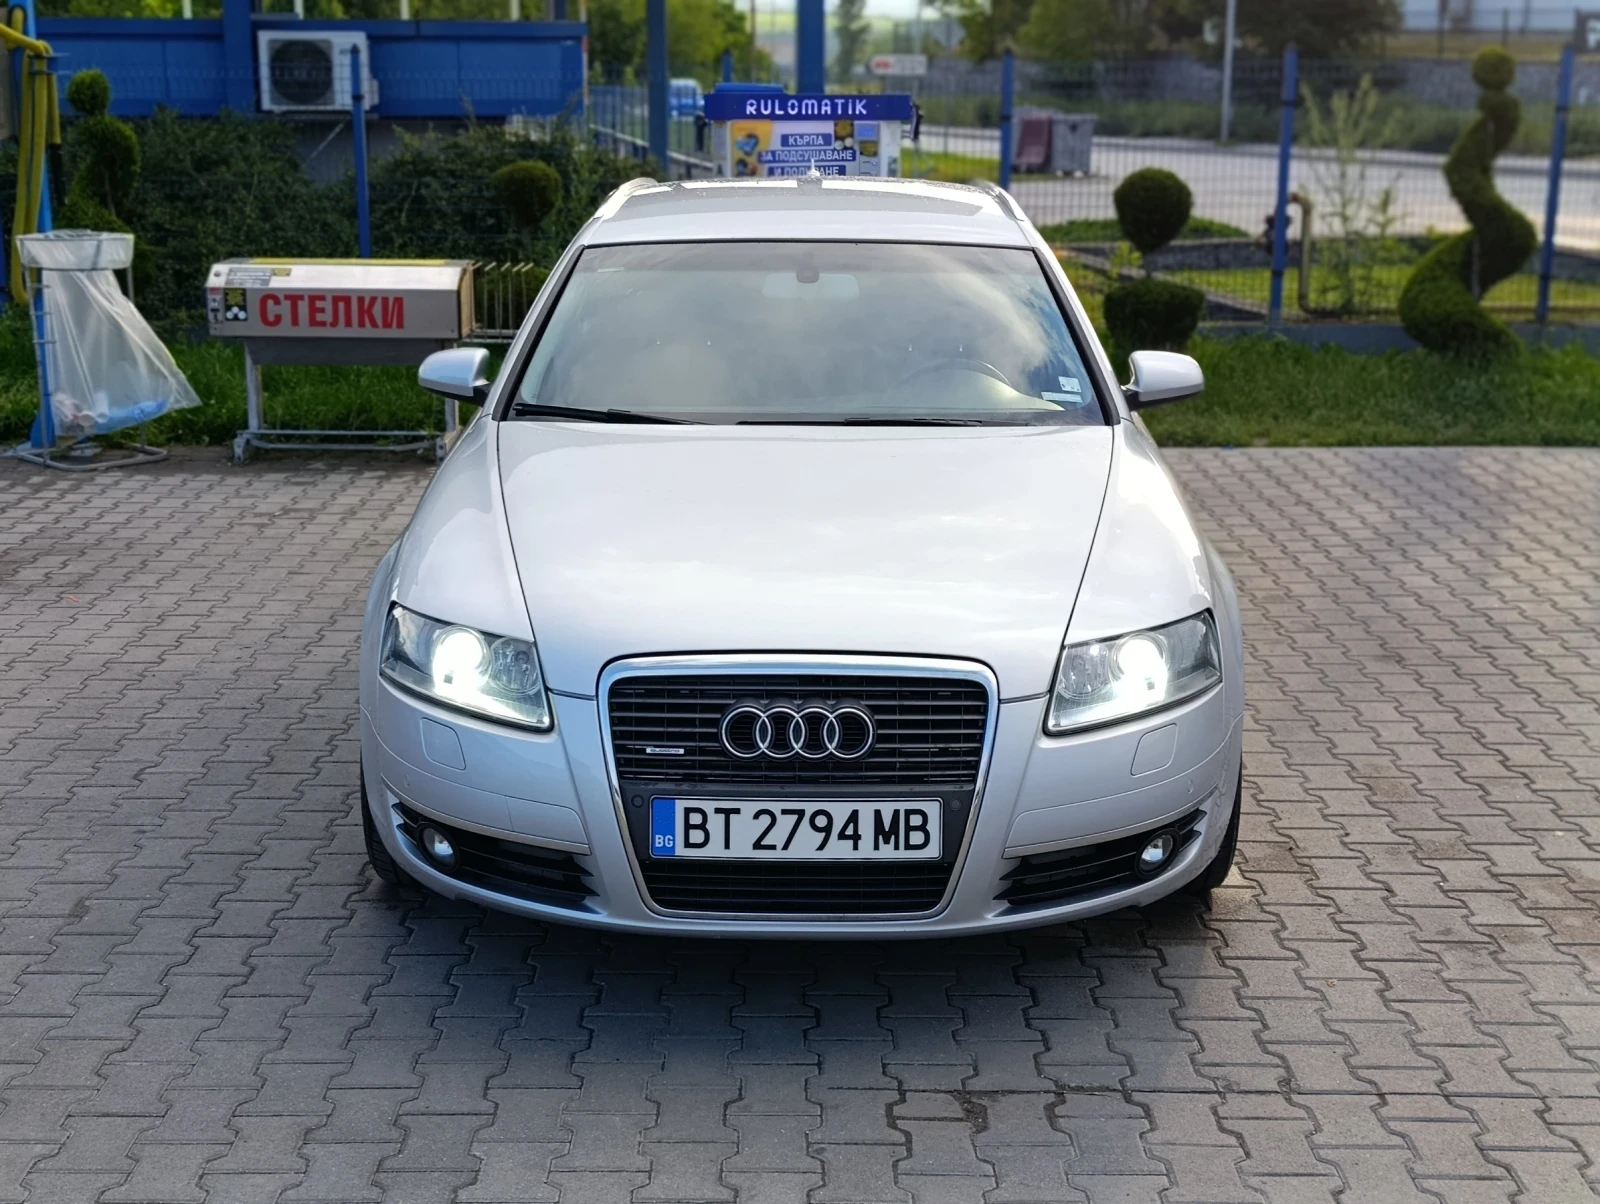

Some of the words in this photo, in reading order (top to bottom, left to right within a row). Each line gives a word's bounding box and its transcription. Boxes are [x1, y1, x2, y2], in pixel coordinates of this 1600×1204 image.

[788, 135, 824, 146] КЪРПА
[775, 150, 853, 162] ПОДСУШАВАНЕ
[259, 293, 405, 329] СТЕЛКИ
[683, 806, 741, 850] BT
[752, 808, 862, 851] 2794
[873, 808, 931, 851] MB
[655, 834, 674, 848] BG
